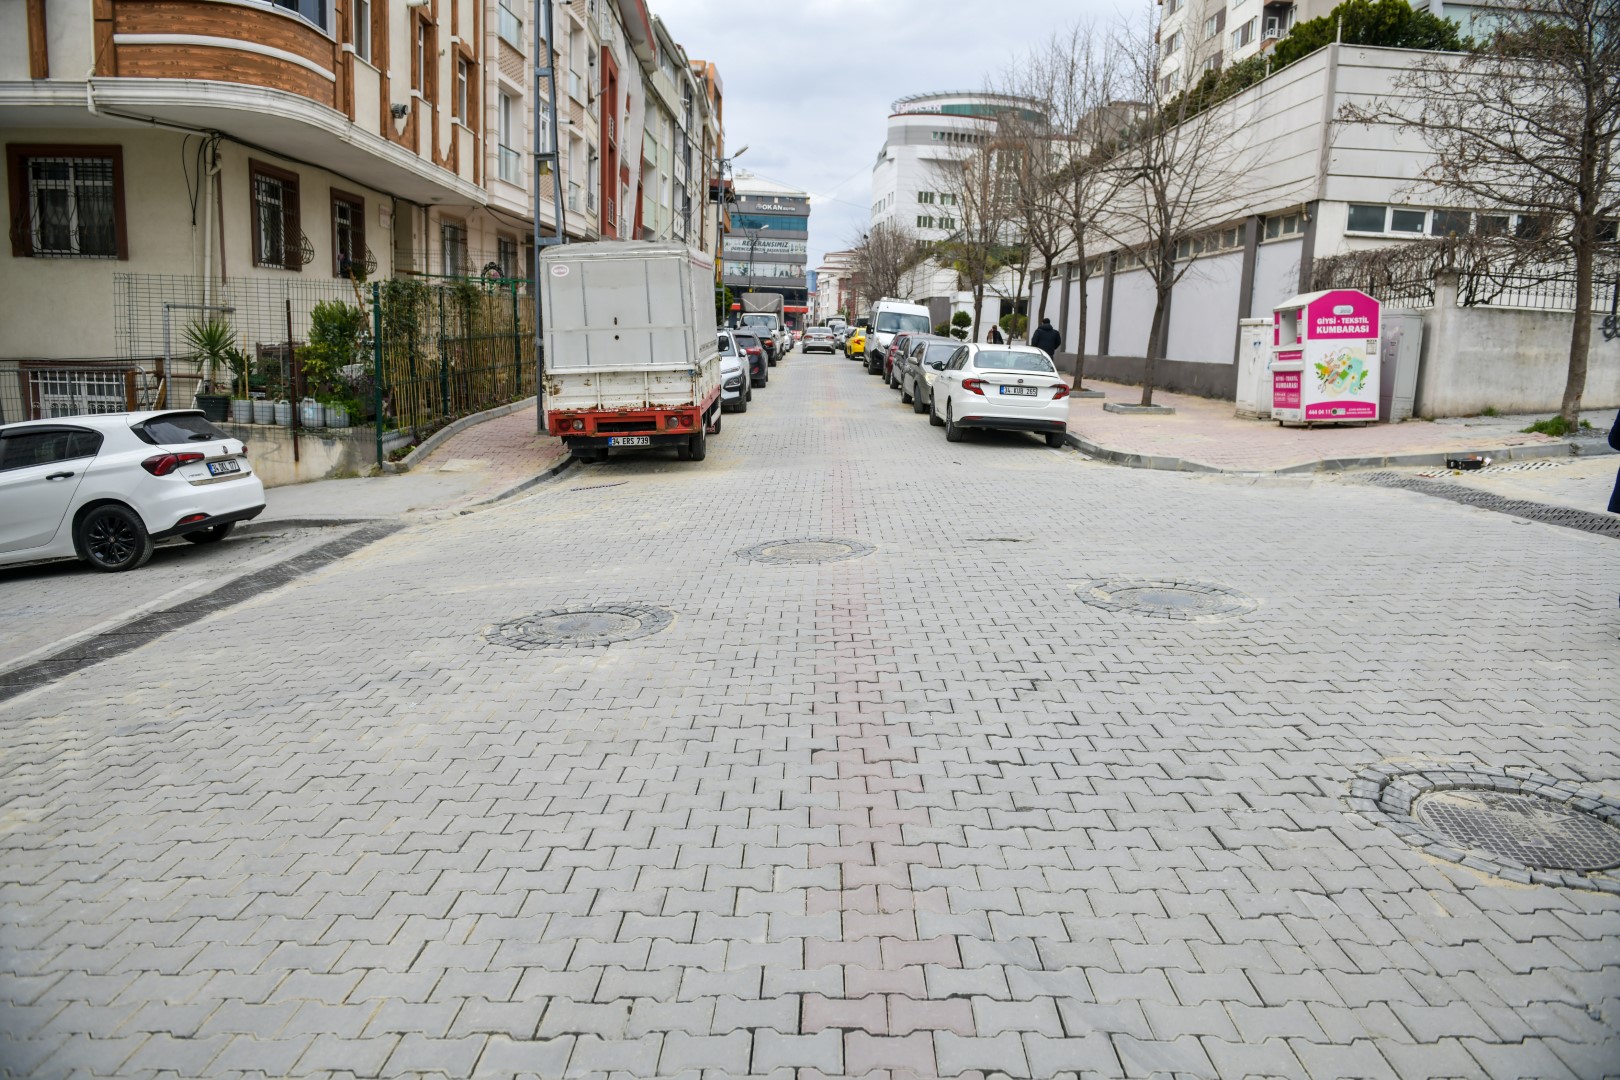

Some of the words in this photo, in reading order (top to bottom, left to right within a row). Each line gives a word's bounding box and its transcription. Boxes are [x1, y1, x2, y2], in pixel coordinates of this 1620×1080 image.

[1317, 316, 1336, 325] GİYSİ
[1341, 315, 1369, 324] TEKSTİL
[611, 437, 620, 445] 34
[622, 437, 635, 445] ERS
[637, 436, 649, 445] 739
